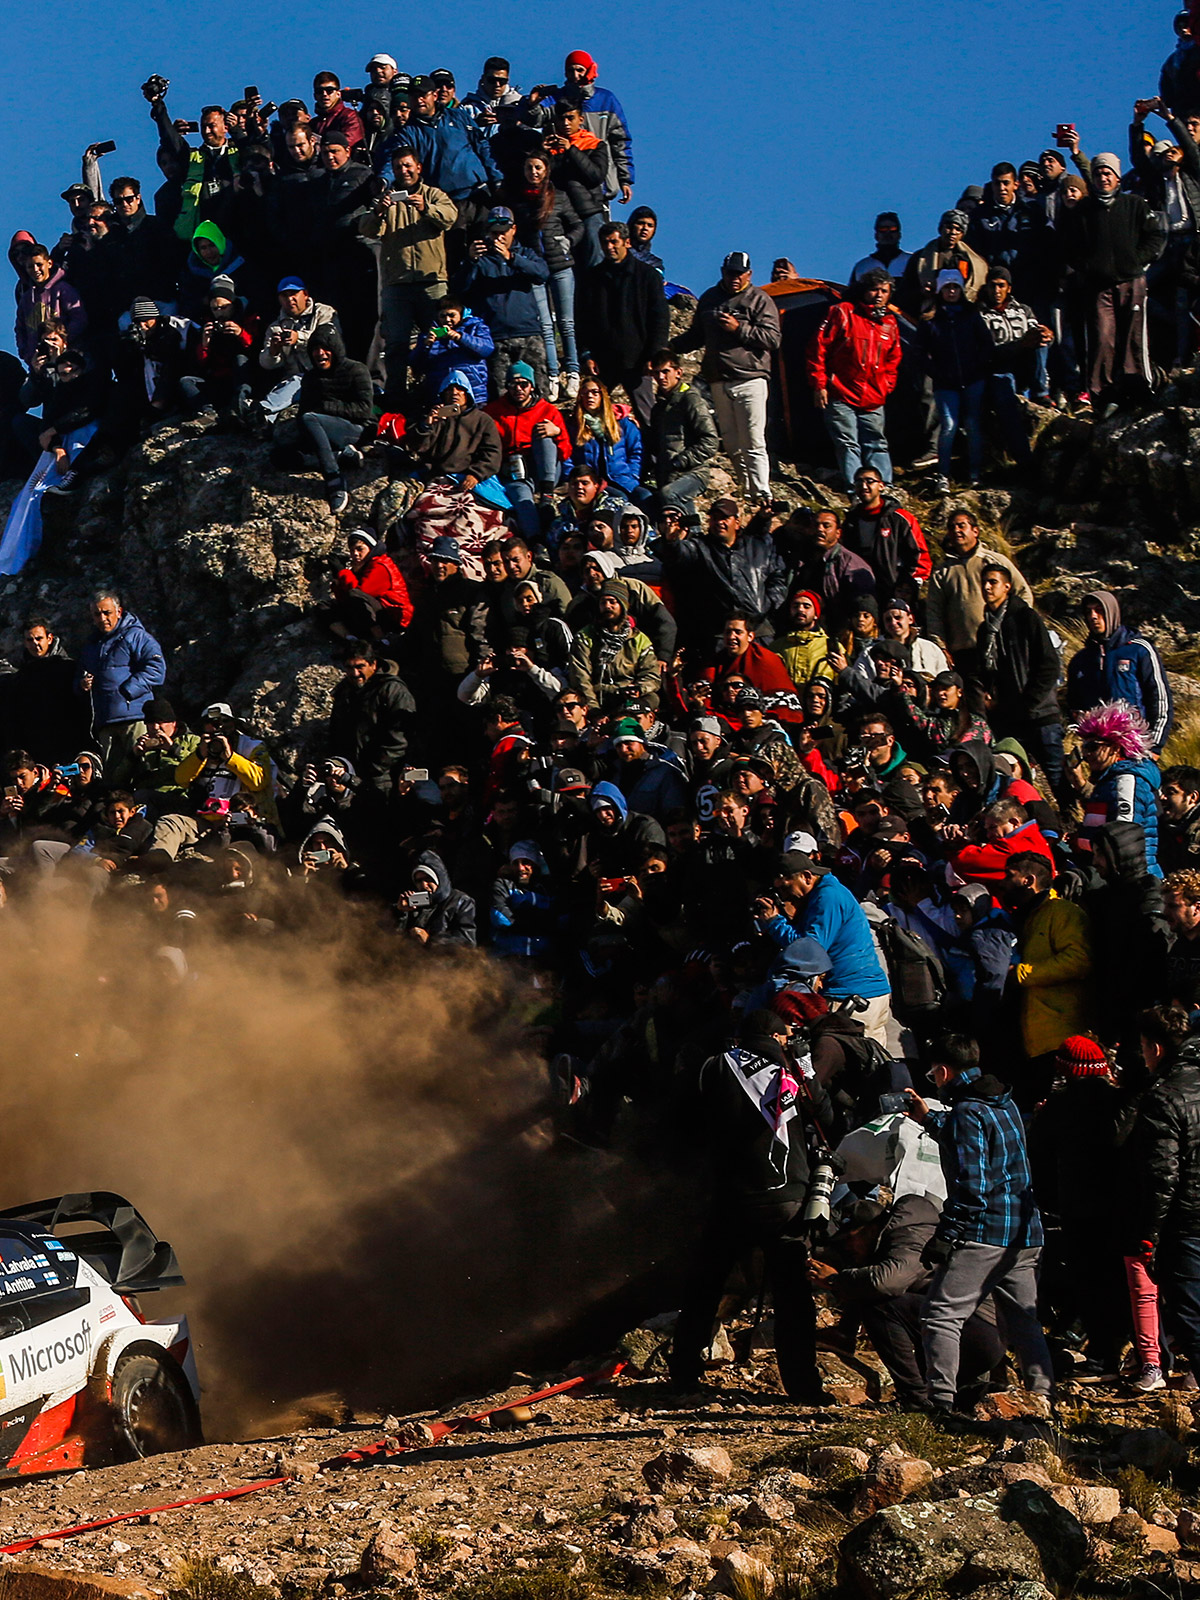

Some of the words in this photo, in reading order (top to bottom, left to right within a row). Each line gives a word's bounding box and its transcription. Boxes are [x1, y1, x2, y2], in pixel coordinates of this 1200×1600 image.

[4, 1256, 37, 1276] Latvala
[5, 1276, 37, 1295] Anttila
[8, 1319, 93, 1385] Microsoft
